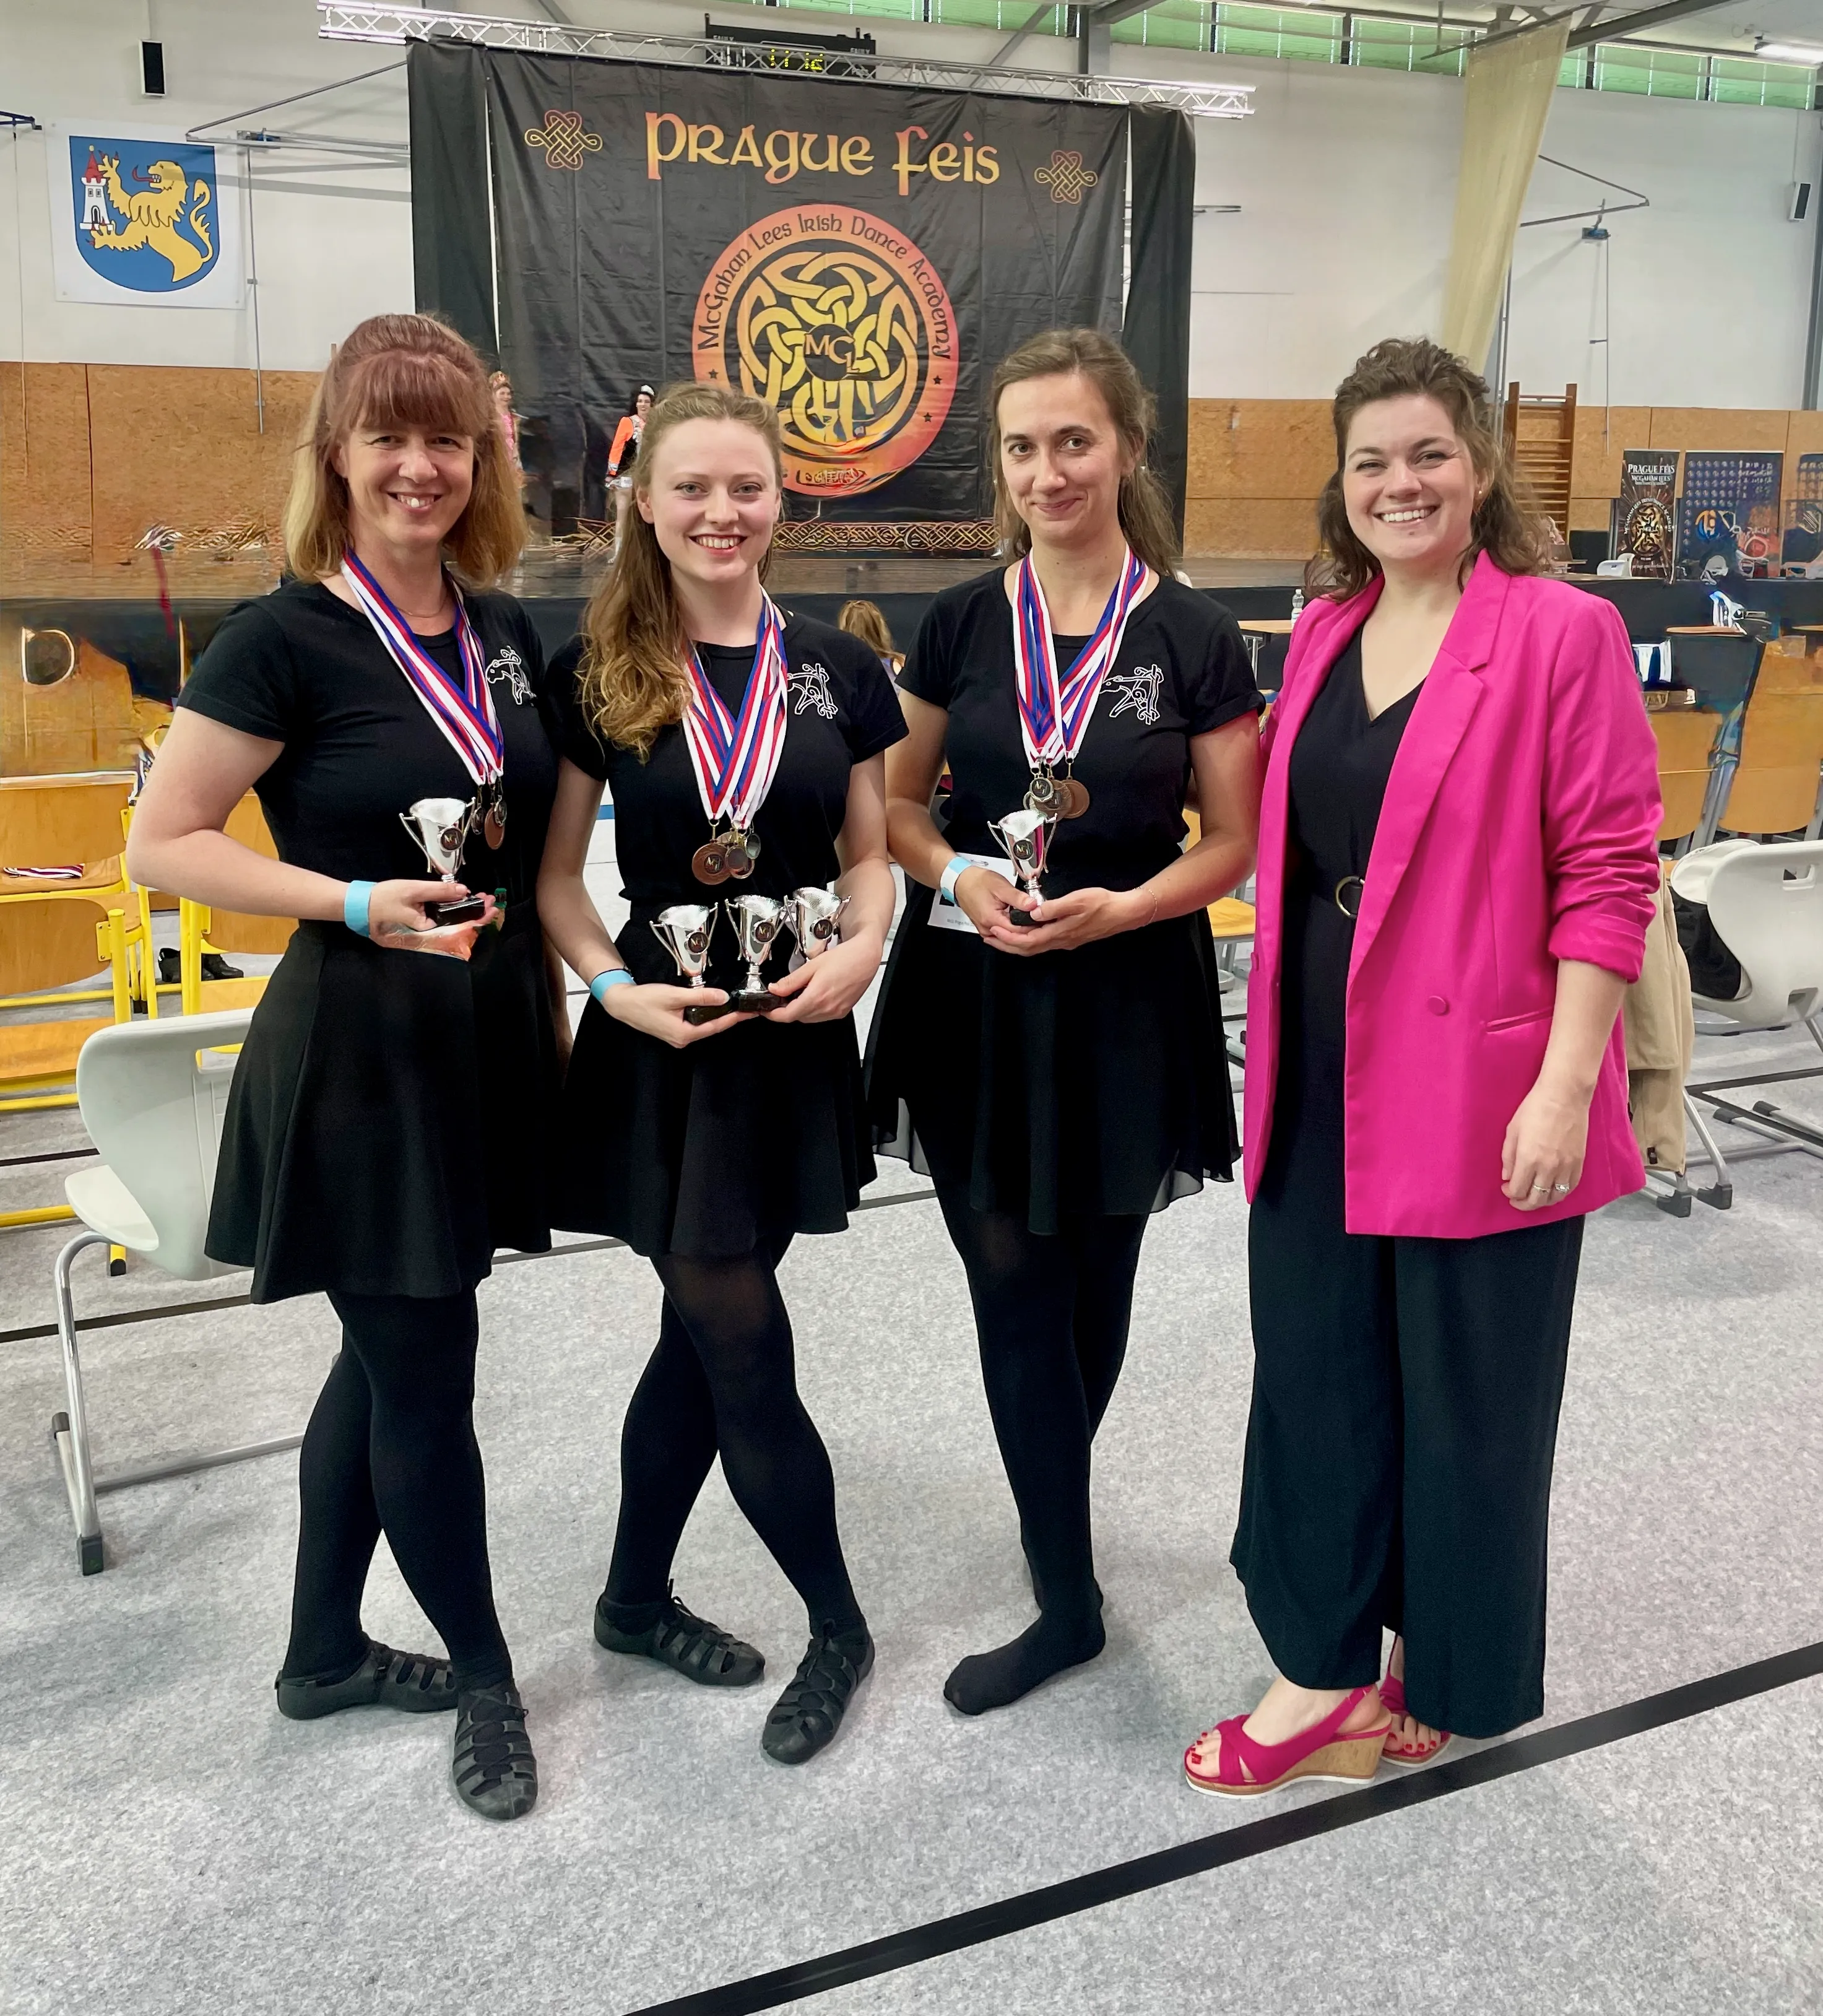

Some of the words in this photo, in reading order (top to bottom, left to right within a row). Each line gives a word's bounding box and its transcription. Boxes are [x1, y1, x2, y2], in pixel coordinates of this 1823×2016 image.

[698, 248, 753, 351] McGahan
[748, 222, 792, 251] Lees
[797, 213, 842, 233] Irish
[851, 215, 907, 259] Dance
[907, 257, 951, 360] Academy
[1628, 464, 1658, 475] PRAGUE
